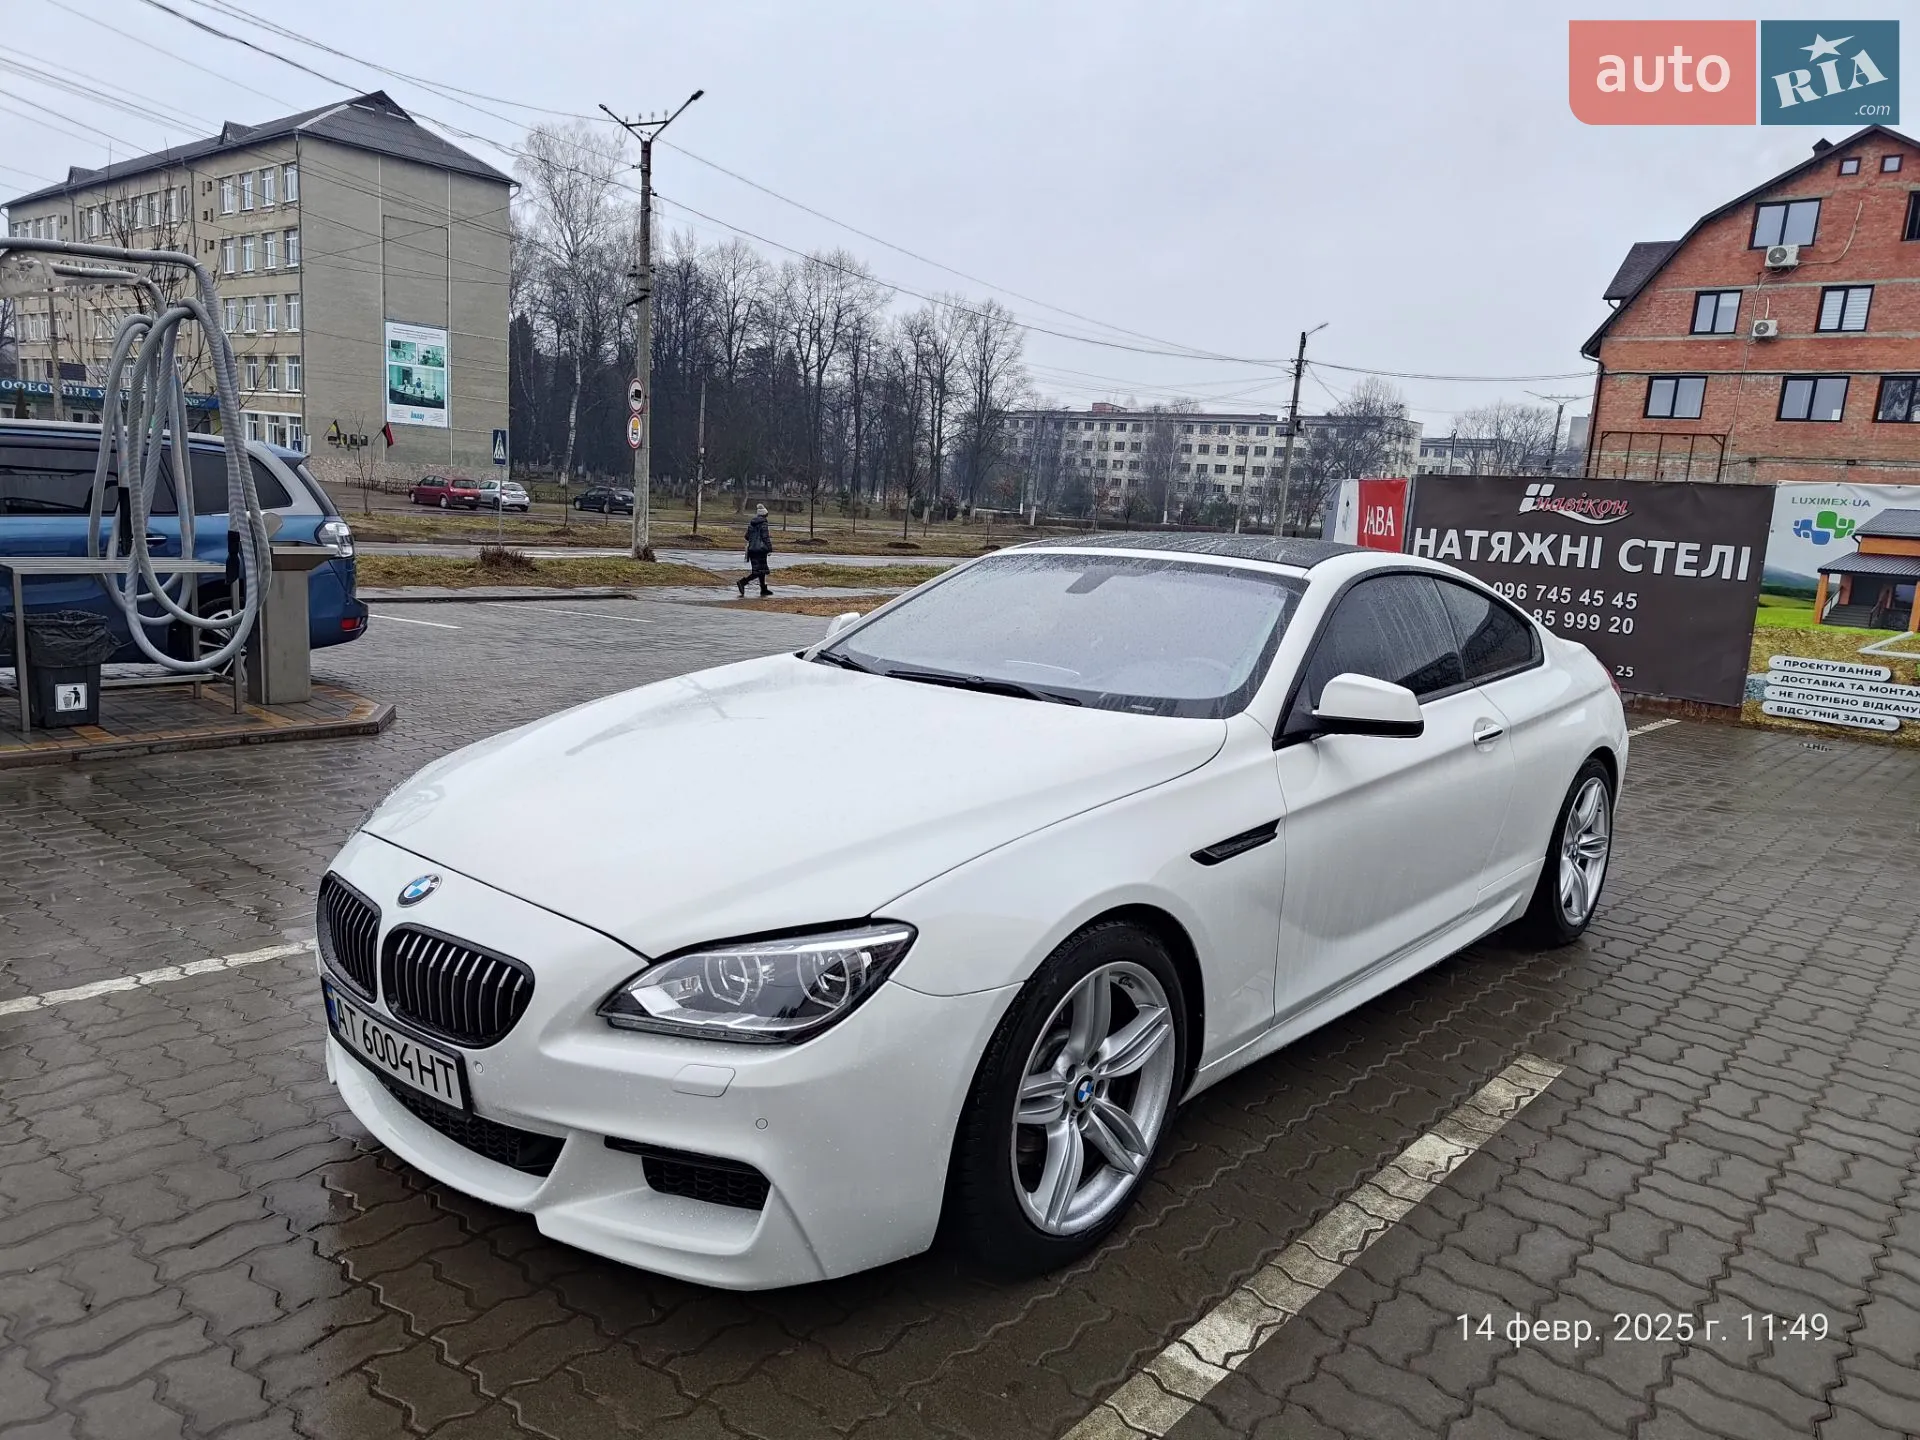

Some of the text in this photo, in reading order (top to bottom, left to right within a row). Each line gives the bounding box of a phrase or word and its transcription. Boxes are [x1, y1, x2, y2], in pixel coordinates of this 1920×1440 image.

[1412, 527, 1752, 581] НАТЯЖНІ СТЕЛІ
[1493, 582, 1638, 610] 096 745 45 45
[1563, 612, 1601, 631] 999
[1608, 616, 1634, 634] 20
[1616, 665, 1634, 677] 25
[1783, 659, 1882, 677] ПРОЄКТУВАННЯ
[1780, 675, 1845, 689] ДОСТАВКА
[1850, 683, 1865, 692] ТА
[1779, 690, 1794, 699] НЕ
[1797, 692, 1859, 707] ПОТРІБНО
[1776, 705, 1886, 726] ВІДСУТНІЙ ЗАПАХ
